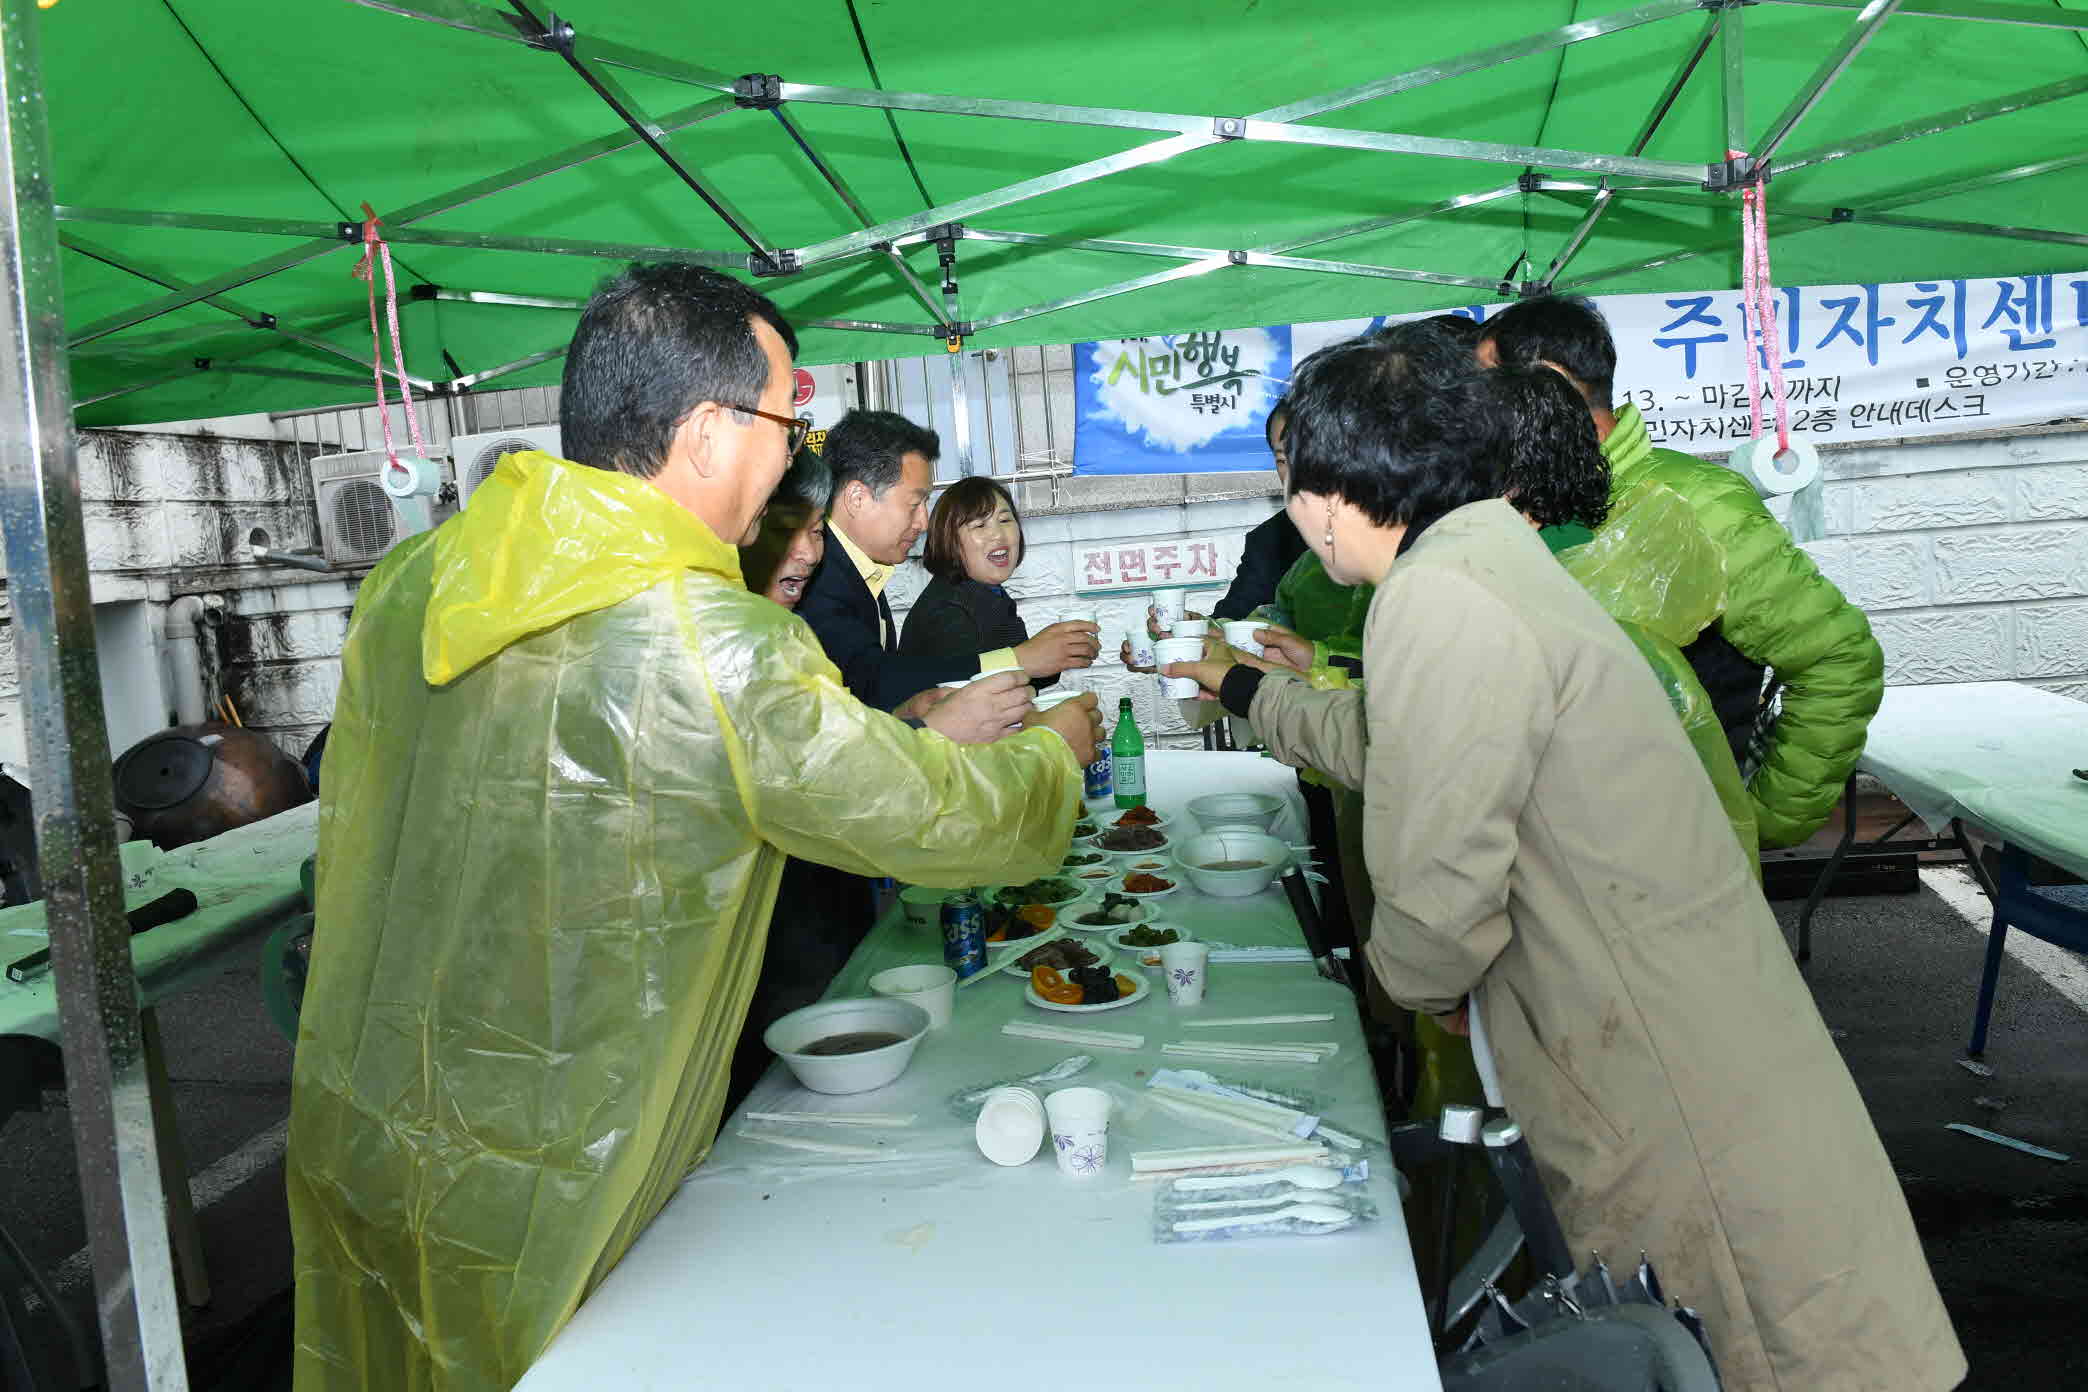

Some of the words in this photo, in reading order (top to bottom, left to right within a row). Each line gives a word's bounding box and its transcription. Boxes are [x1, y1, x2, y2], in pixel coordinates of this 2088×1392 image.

[1944, 359, 2062, 389] 운영기간
[1190, 393, 1237, 414] 특별시
[1644, 413, 1780, 443] 민자치센터
[1791, 407, 1837, 432] 2층
[1849, 394, 1991, 429] 안내데스크
[1084, 542, 1218, 585] 전면주차
